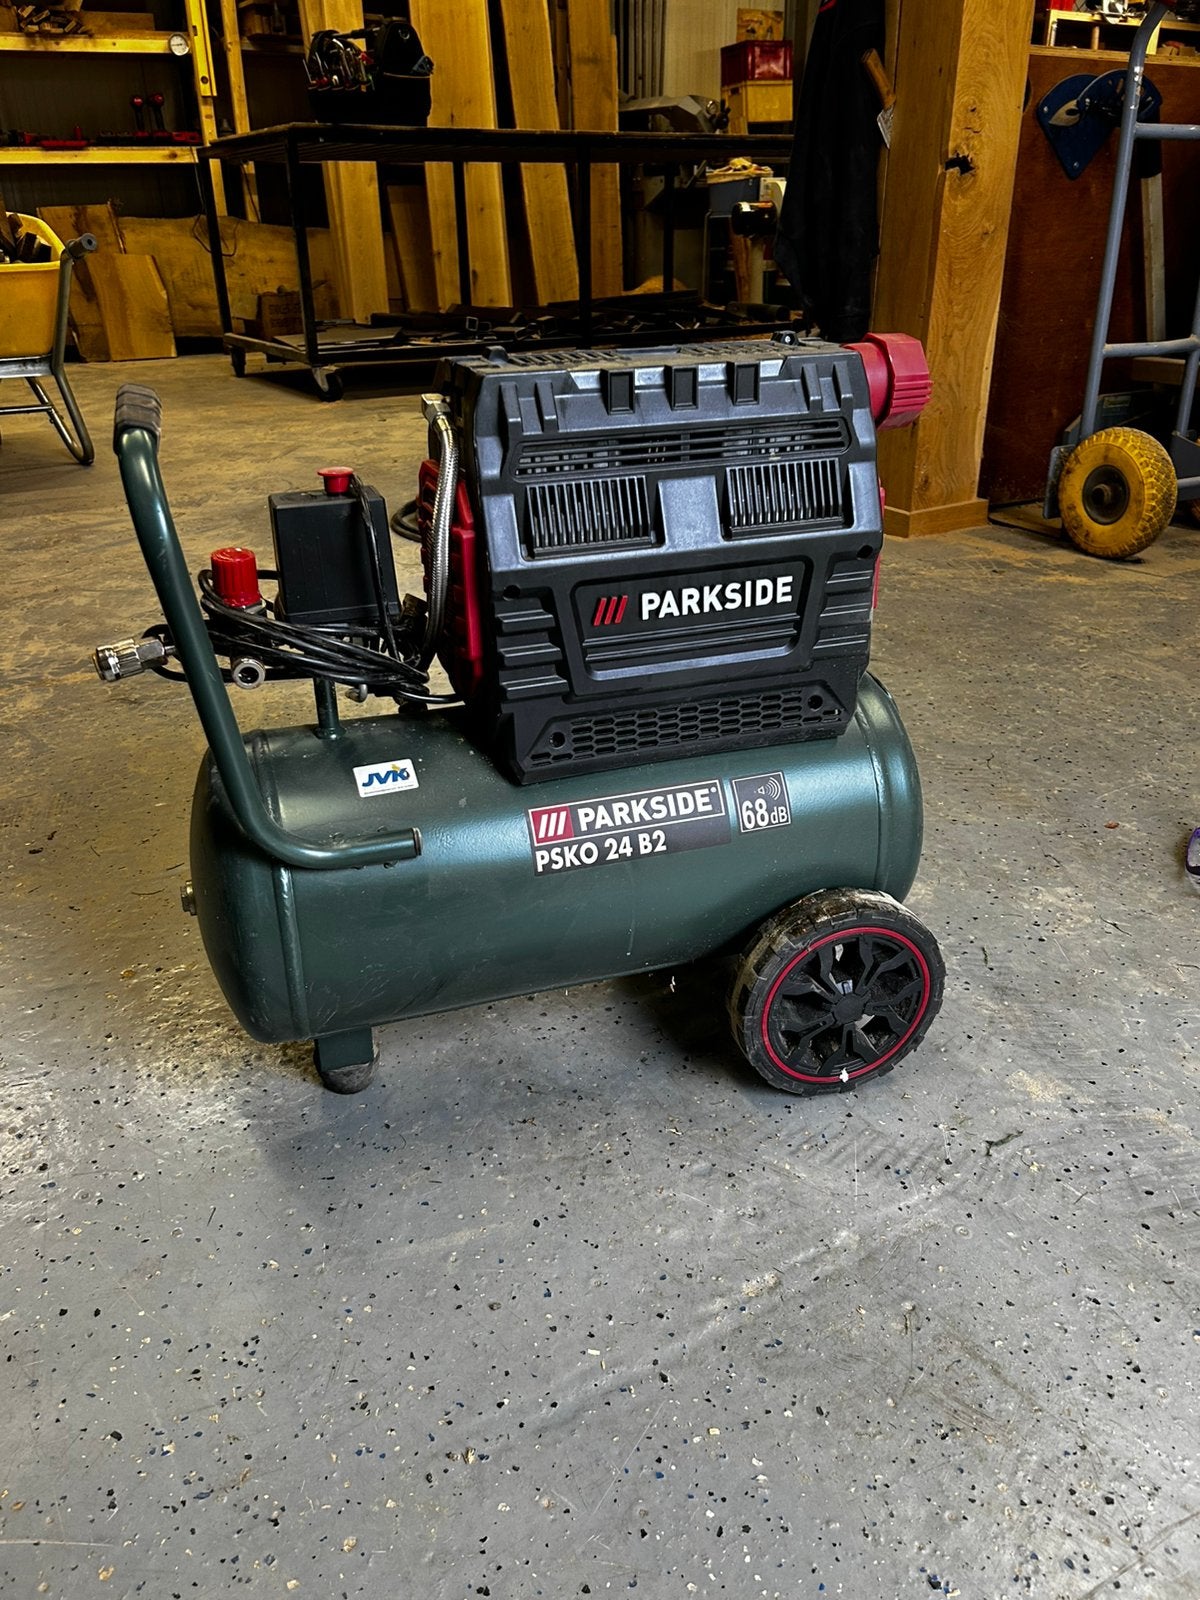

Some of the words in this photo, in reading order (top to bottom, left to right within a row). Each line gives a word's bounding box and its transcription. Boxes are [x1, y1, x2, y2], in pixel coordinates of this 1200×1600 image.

[641, 575, 793, 621] PARKSIDE
[535, 841, 599, 873] PSKO
[604, 835, 634, 861] 24
[638, 829, 668, 856] B2
